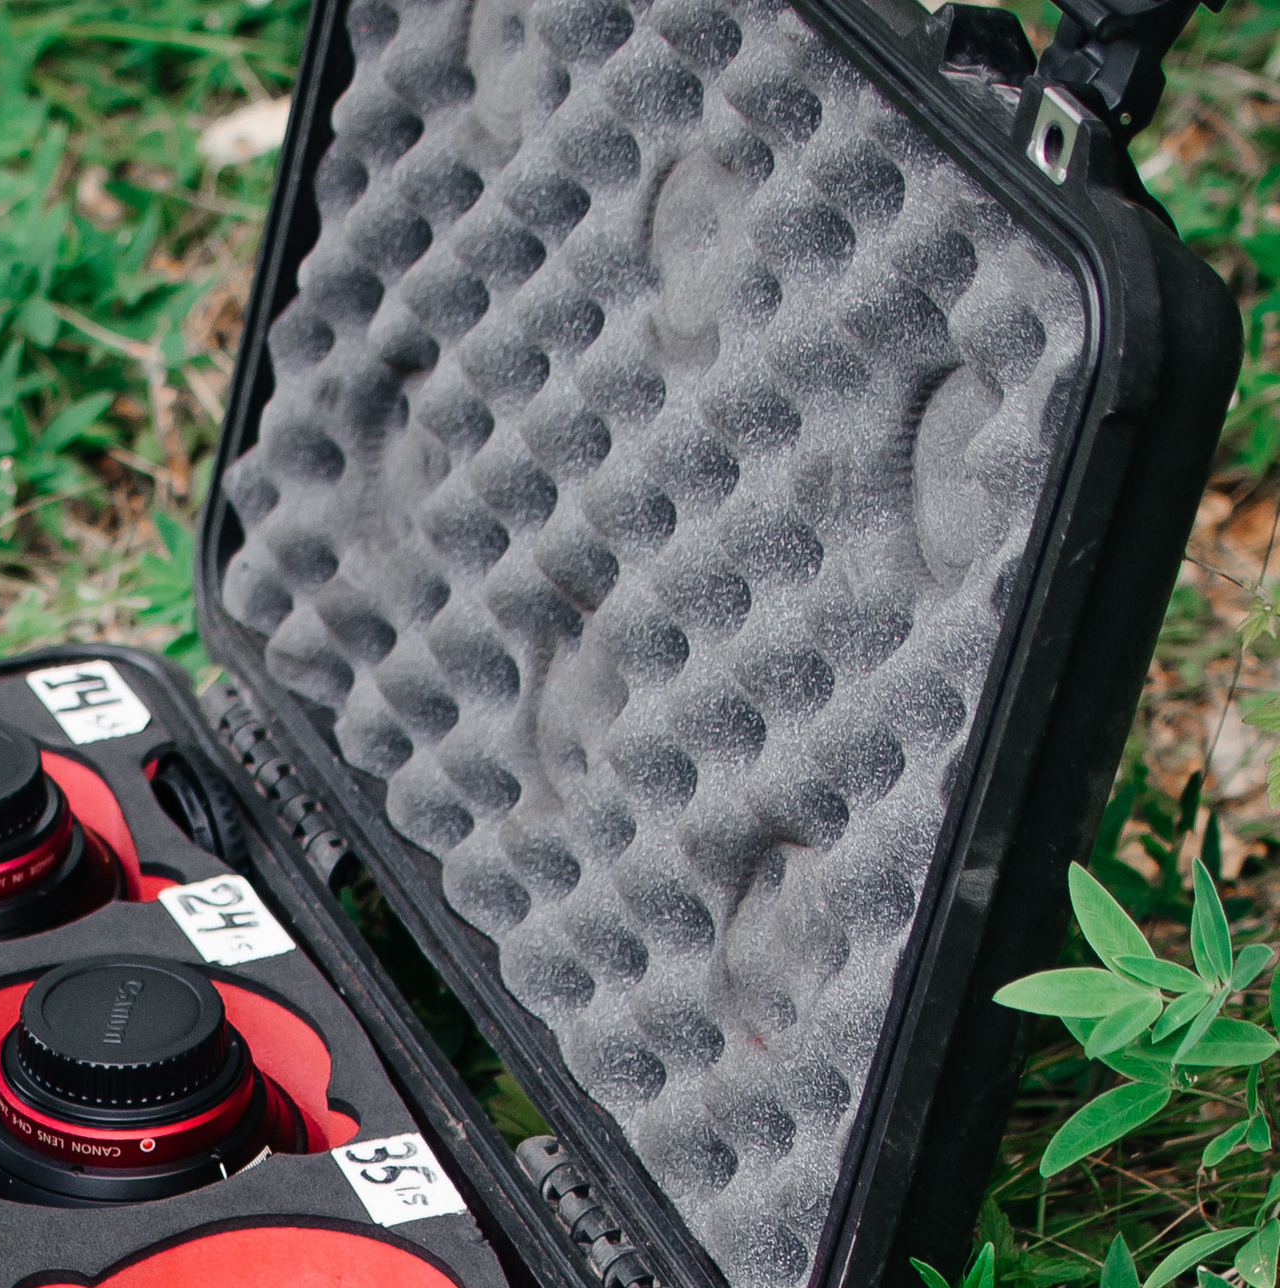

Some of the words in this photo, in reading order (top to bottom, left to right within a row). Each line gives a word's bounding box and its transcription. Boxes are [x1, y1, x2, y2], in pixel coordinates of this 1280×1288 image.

[41, 672, 122, 713] 14
[177, 882, 260, 933] 24
[102, 980, 144, 1043] Canon
[12, 1113, 33, 1135] CN-E
[36, 1131, 65, 1149] LENS
[71, 1141, 122, 1158] CANON
[345, 1141, 438, 1185] 35
